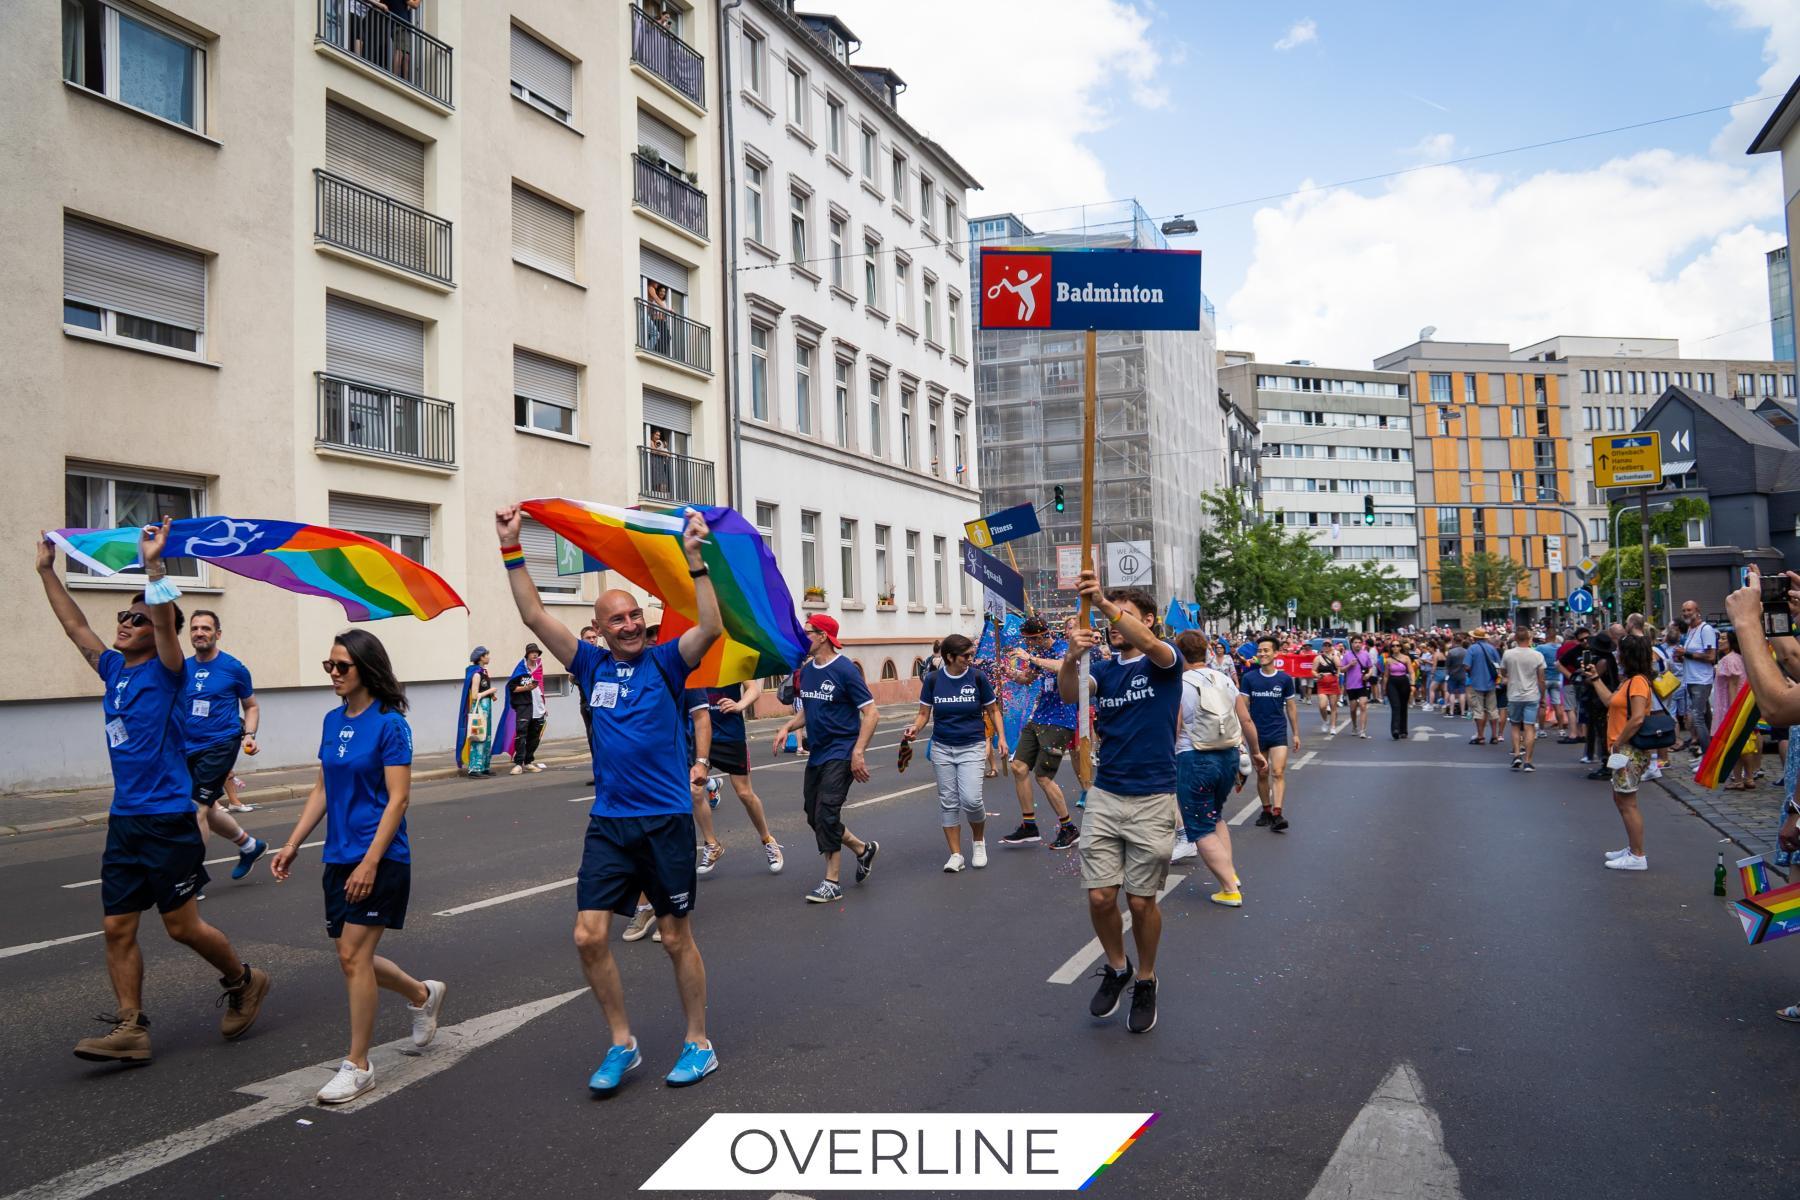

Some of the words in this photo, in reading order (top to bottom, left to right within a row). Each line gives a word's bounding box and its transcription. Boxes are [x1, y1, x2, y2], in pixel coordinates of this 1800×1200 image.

[1056, 281, 1164, 303] Badminton
[989, 523, 1013, 536] Fitness
[983, 564, 1003, 586] Squash
[933, 695, 976, 703] Frankfurt
